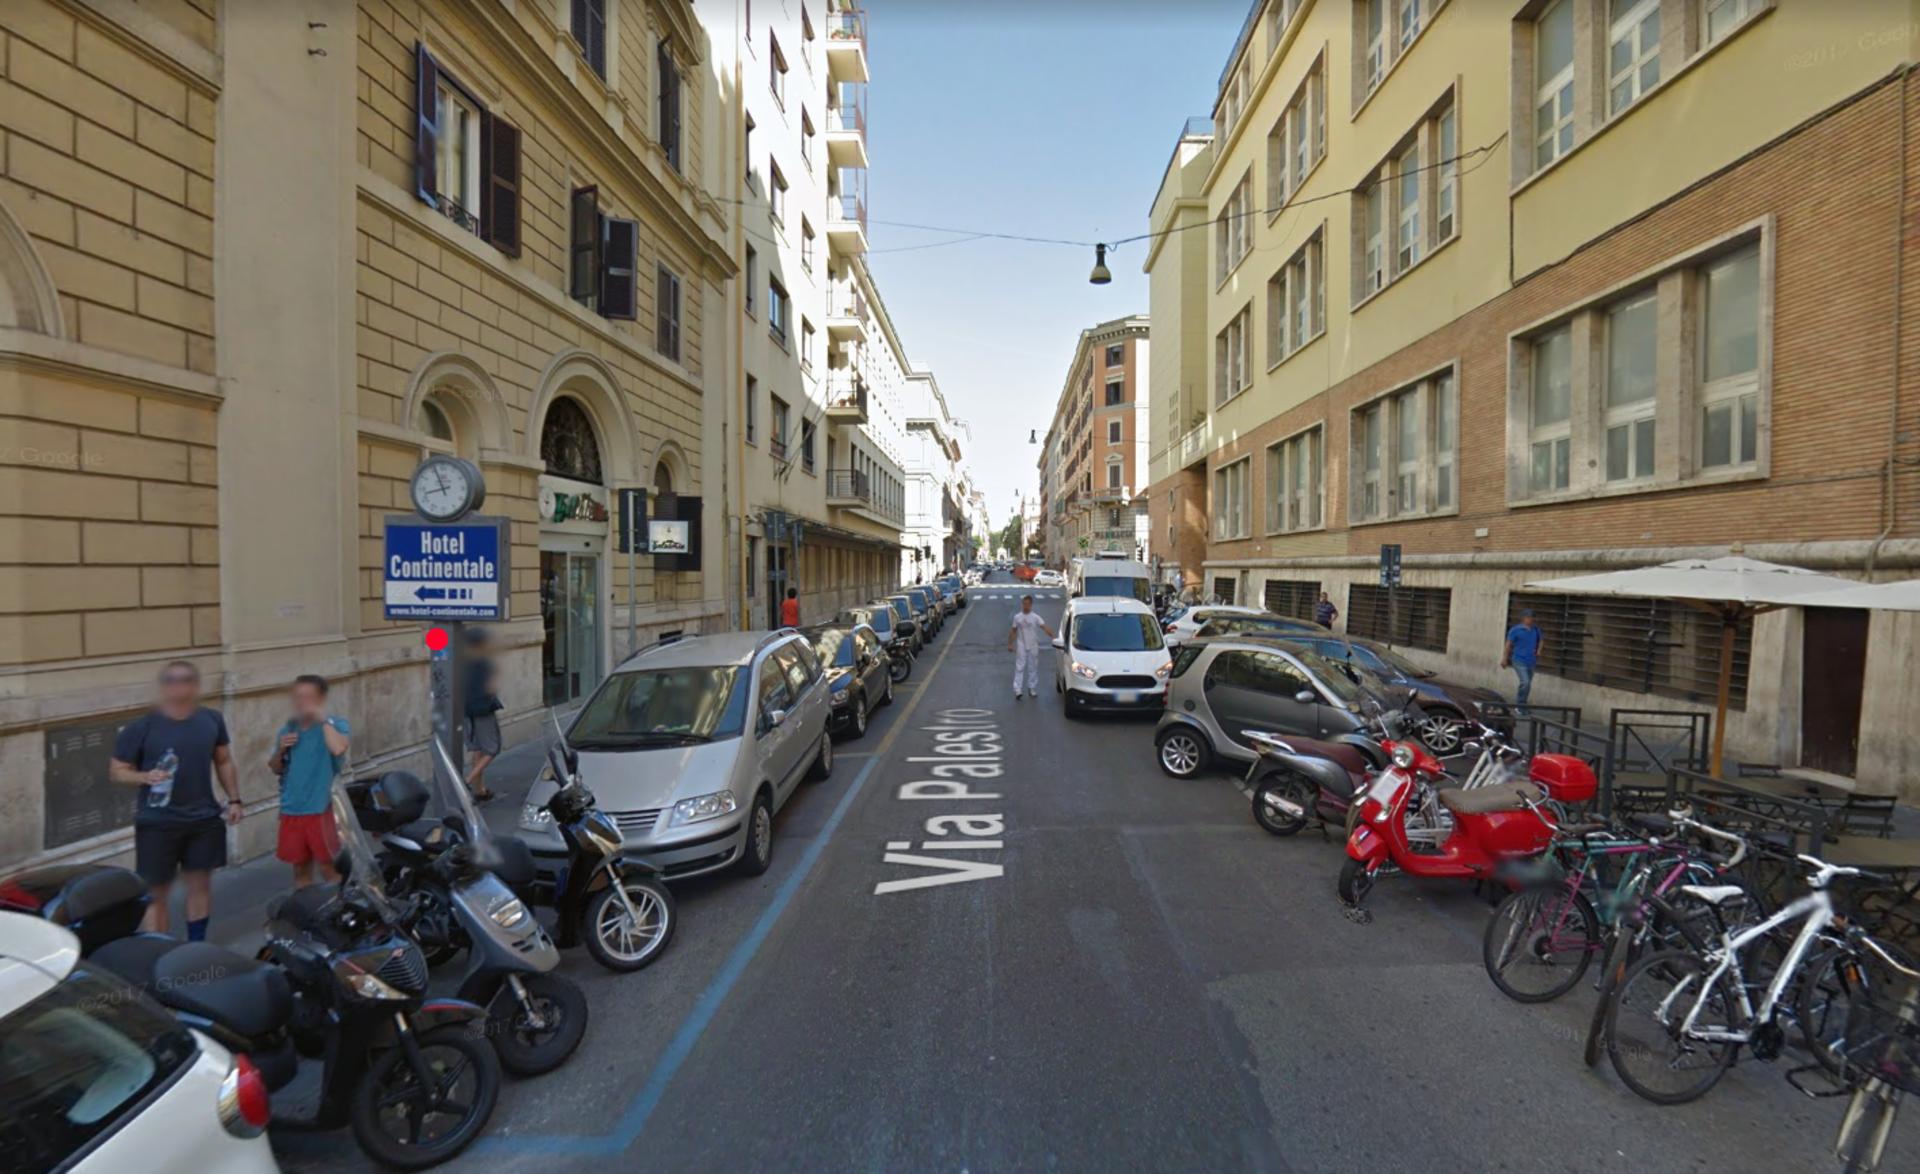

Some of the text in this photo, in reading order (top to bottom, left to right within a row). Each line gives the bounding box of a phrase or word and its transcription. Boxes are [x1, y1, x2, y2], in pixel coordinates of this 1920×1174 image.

[421, 531, 465, 554] Hotel
[391, 555, 495, 579] Continentale
[390, 605, 495, 617] www.hotel-continentale.com
